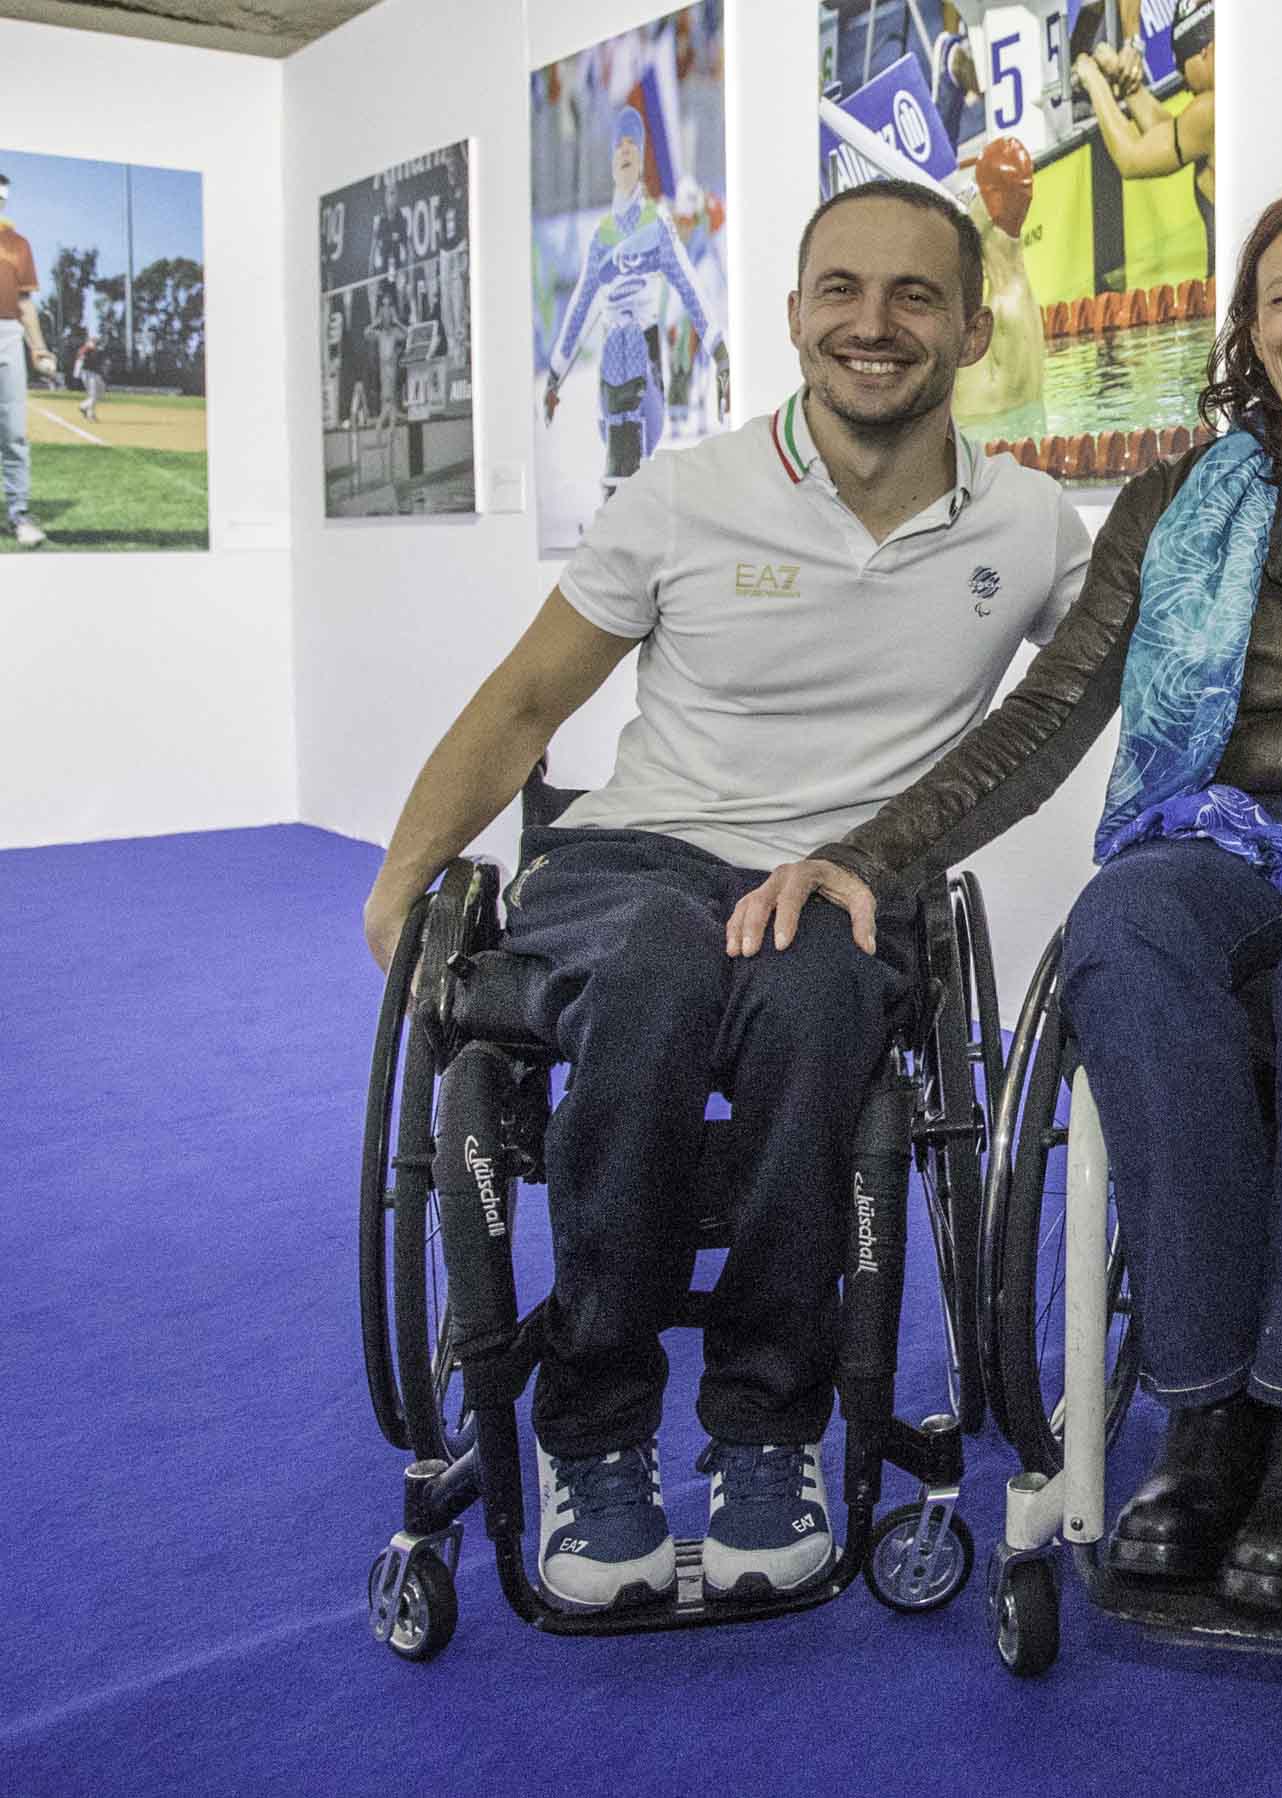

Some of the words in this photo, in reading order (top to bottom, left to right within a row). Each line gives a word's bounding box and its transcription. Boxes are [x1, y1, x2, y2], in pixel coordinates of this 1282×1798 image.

[991, 32, 1024, 130] 5
[735, 562, 801, 591] EA7
[468, 1146, 506, 1237] küschall
[855, 1183, 880, 1274] küschall
[558, 1536, 590, 1553] EA7
[792, 1512, 816, 1533] EA7
